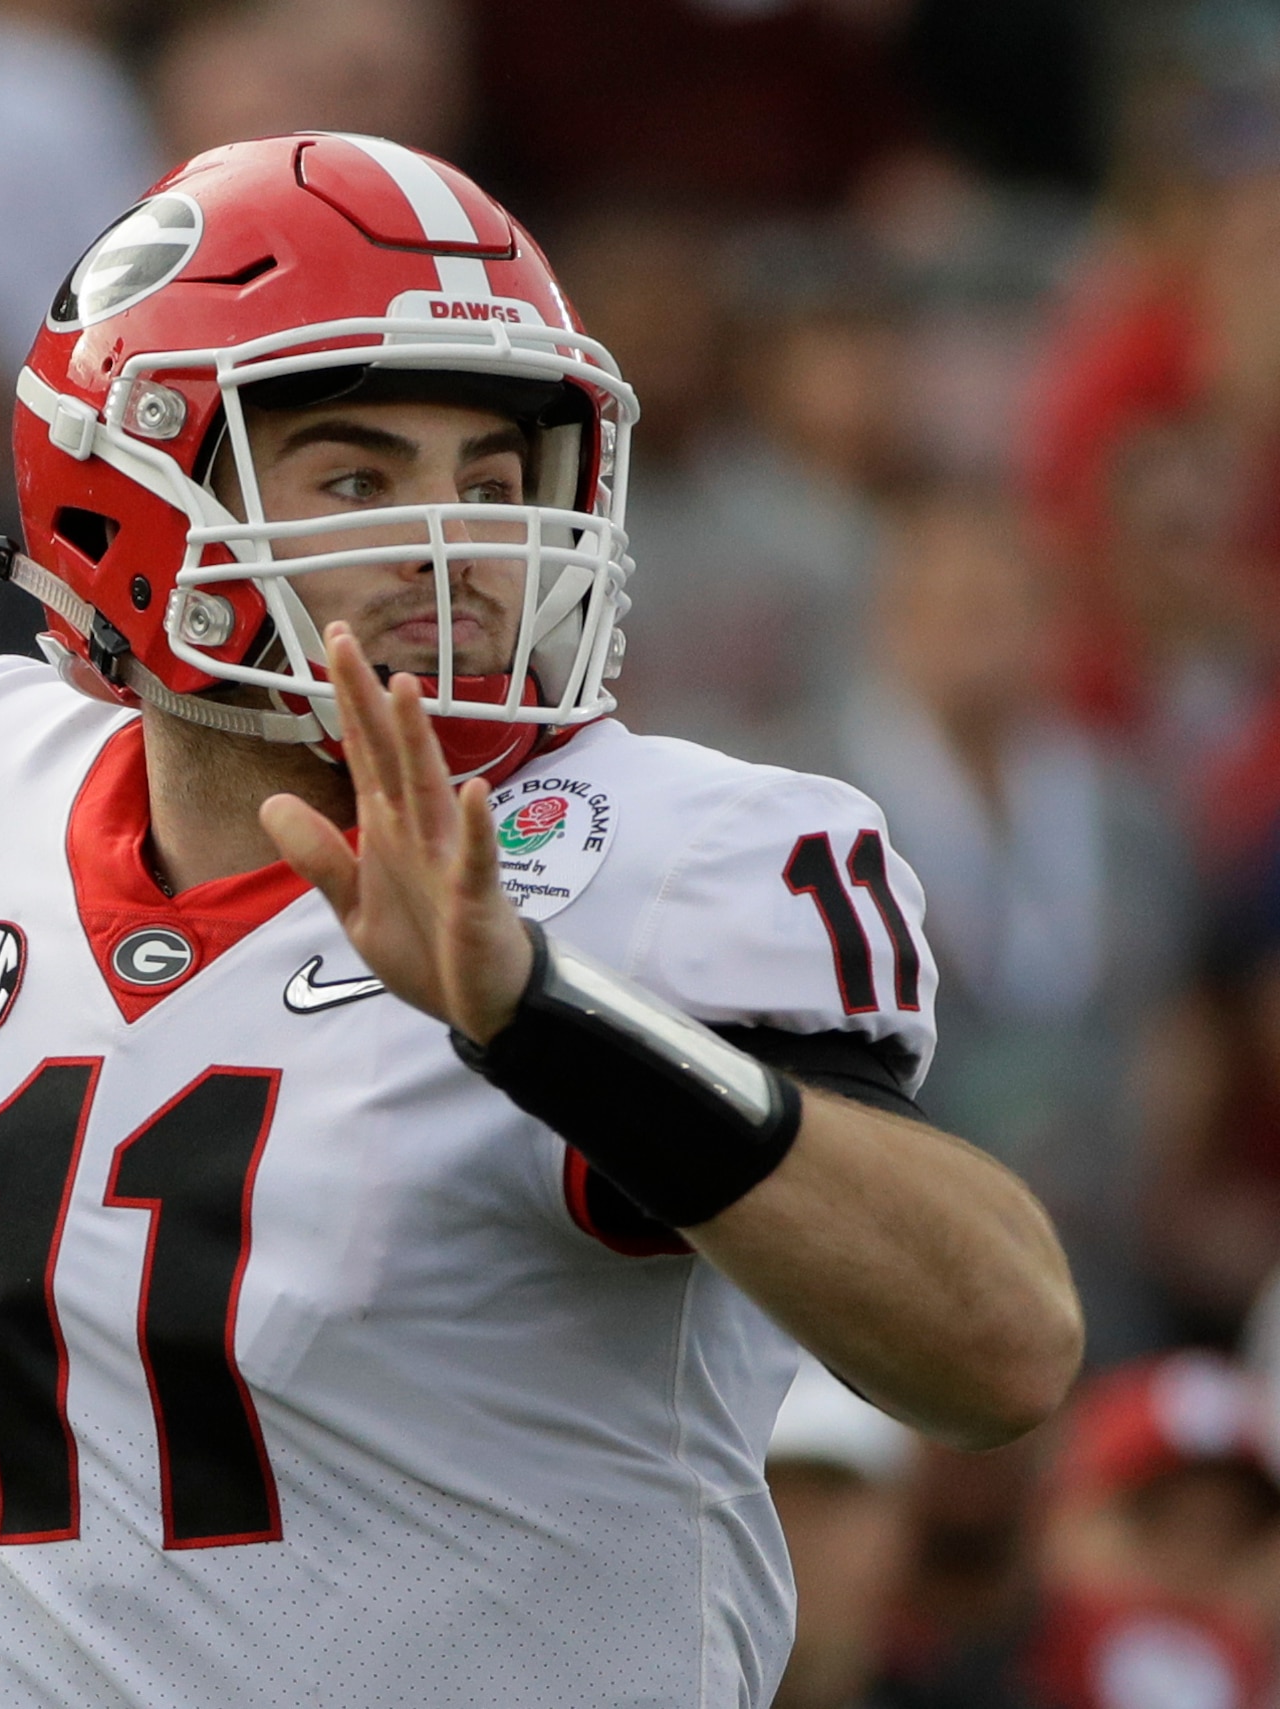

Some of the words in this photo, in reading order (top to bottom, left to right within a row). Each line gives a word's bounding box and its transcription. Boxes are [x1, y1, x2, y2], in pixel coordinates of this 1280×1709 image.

[428, 300, 521, 324] DAWGS
[522, 778, 592, 798] BOWL
[582, 793, 611, 853] GAME
[532, 859, 547, 876] by
[782, 828, 921, 1016] 11
[116, 931, 188, 983] G
